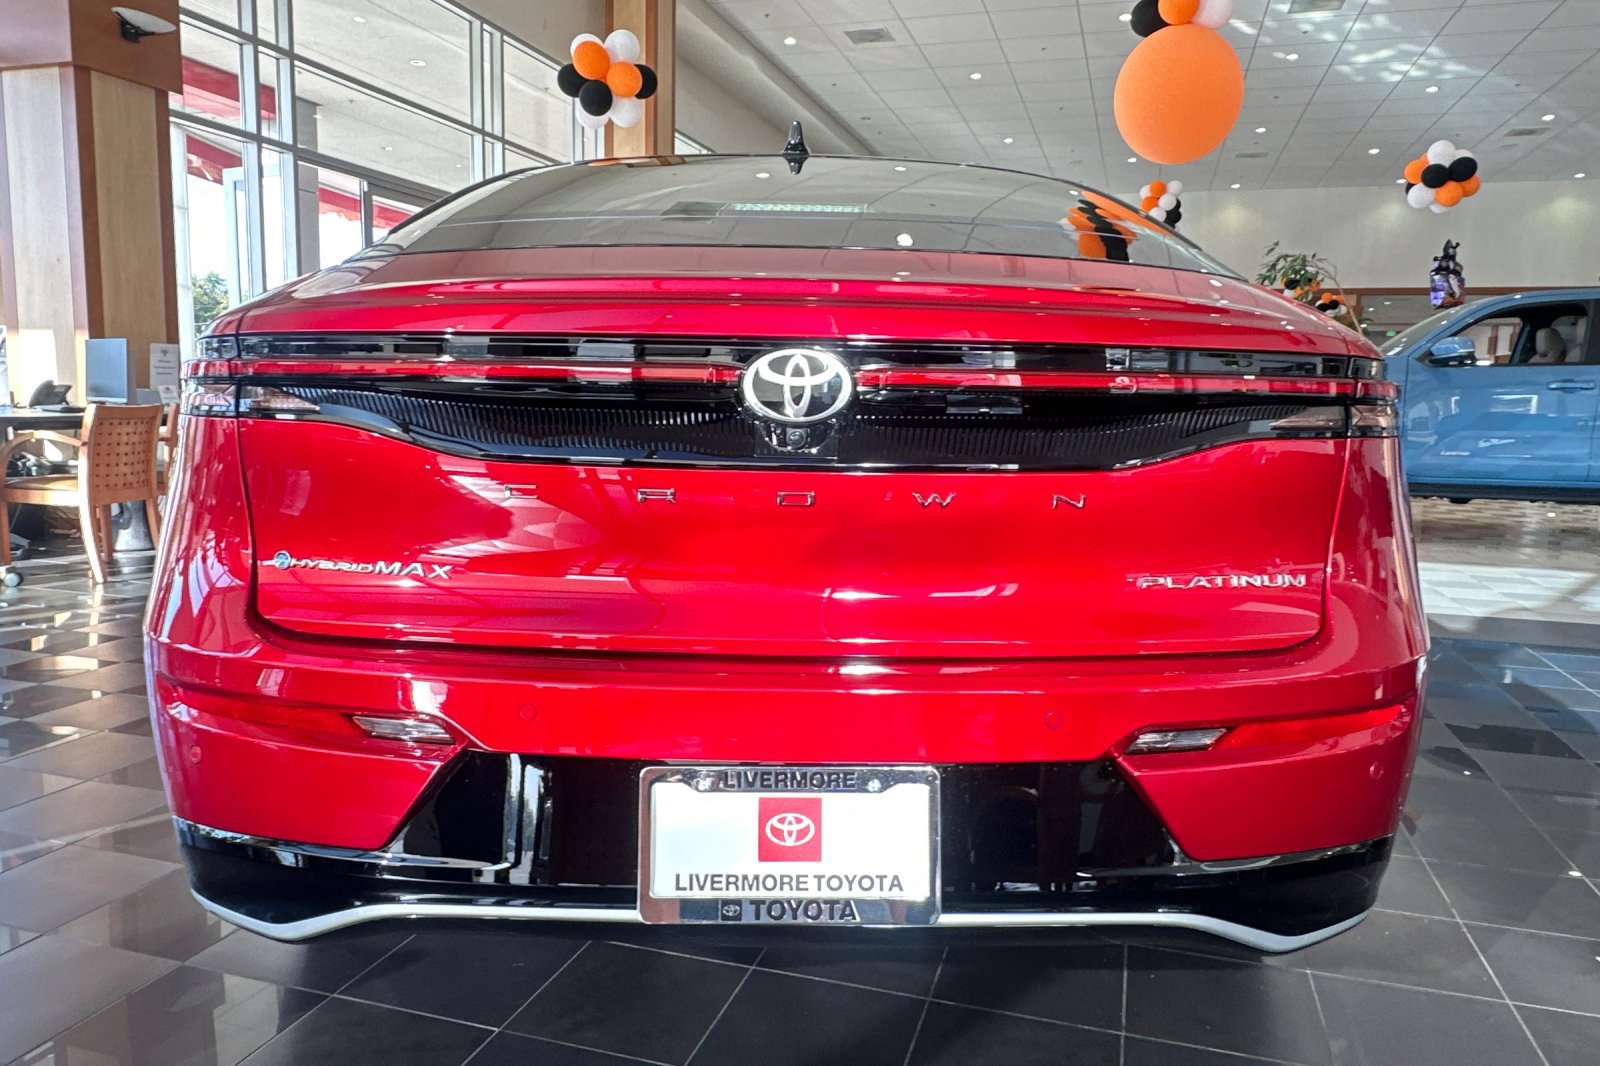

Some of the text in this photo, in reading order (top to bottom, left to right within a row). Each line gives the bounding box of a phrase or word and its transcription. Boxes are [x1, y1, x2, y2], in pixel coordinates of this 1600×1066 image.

[1138, 573, 1307, 589] PLATINUM
[722, 771, 857, 789] LIVERMORE
[675, 873, 904, 892] LIVERMORE TOYOTA
[751, 900, 857, 921] TOYOTA
